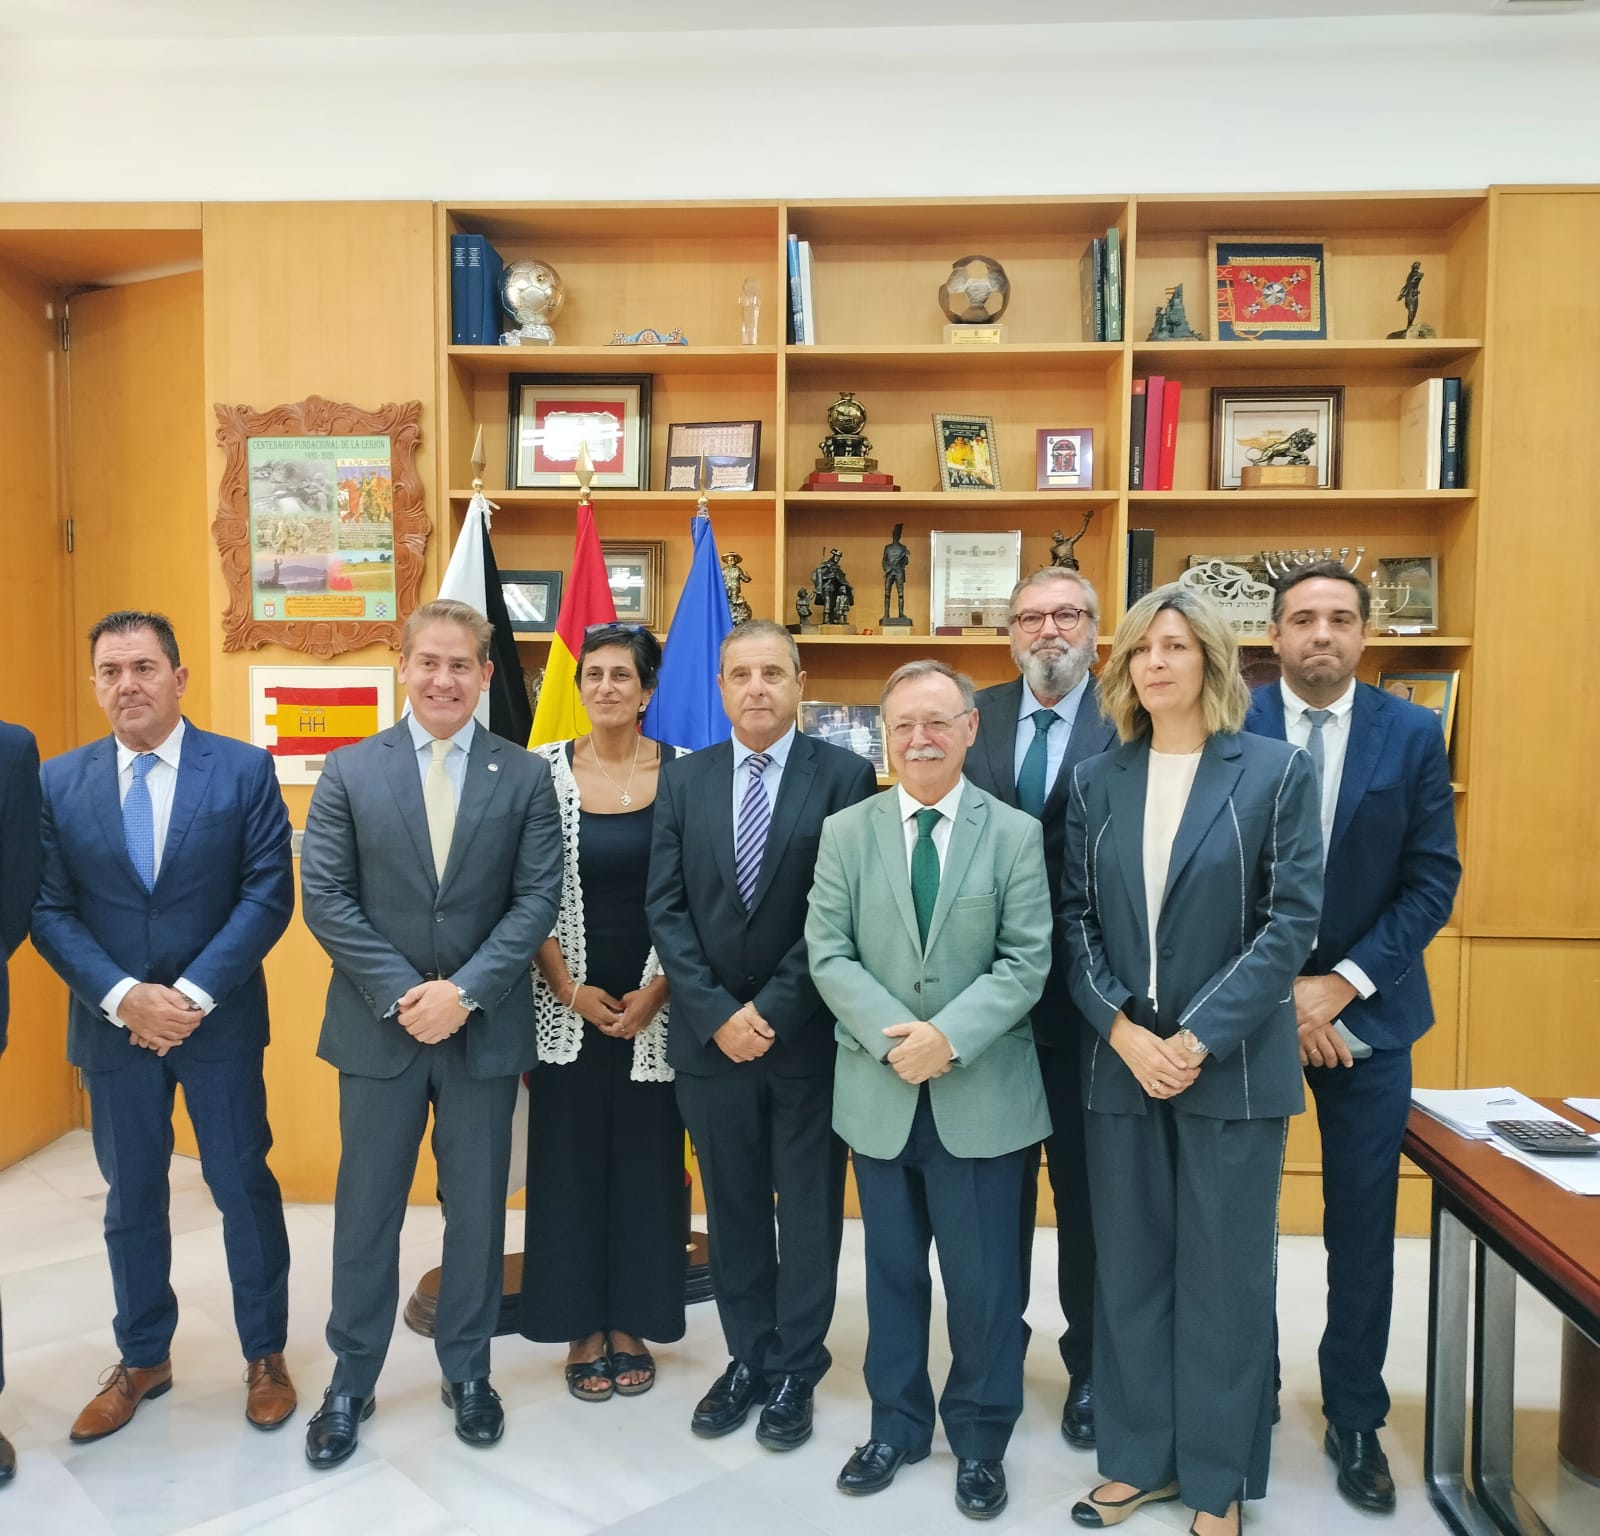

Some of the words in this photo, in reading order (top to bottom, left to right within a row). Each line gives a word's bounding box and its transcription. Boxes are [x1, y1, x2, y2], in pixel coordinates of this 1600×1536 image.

[252, 440, 294, 450] CENTENARIO
[294, 440, 339, 450] FUNDACIONAL
[340, 440, 350, 449] DE
[351, 440, 360, 449] LA
[361, 439, 385, 449] LEGIÓN
